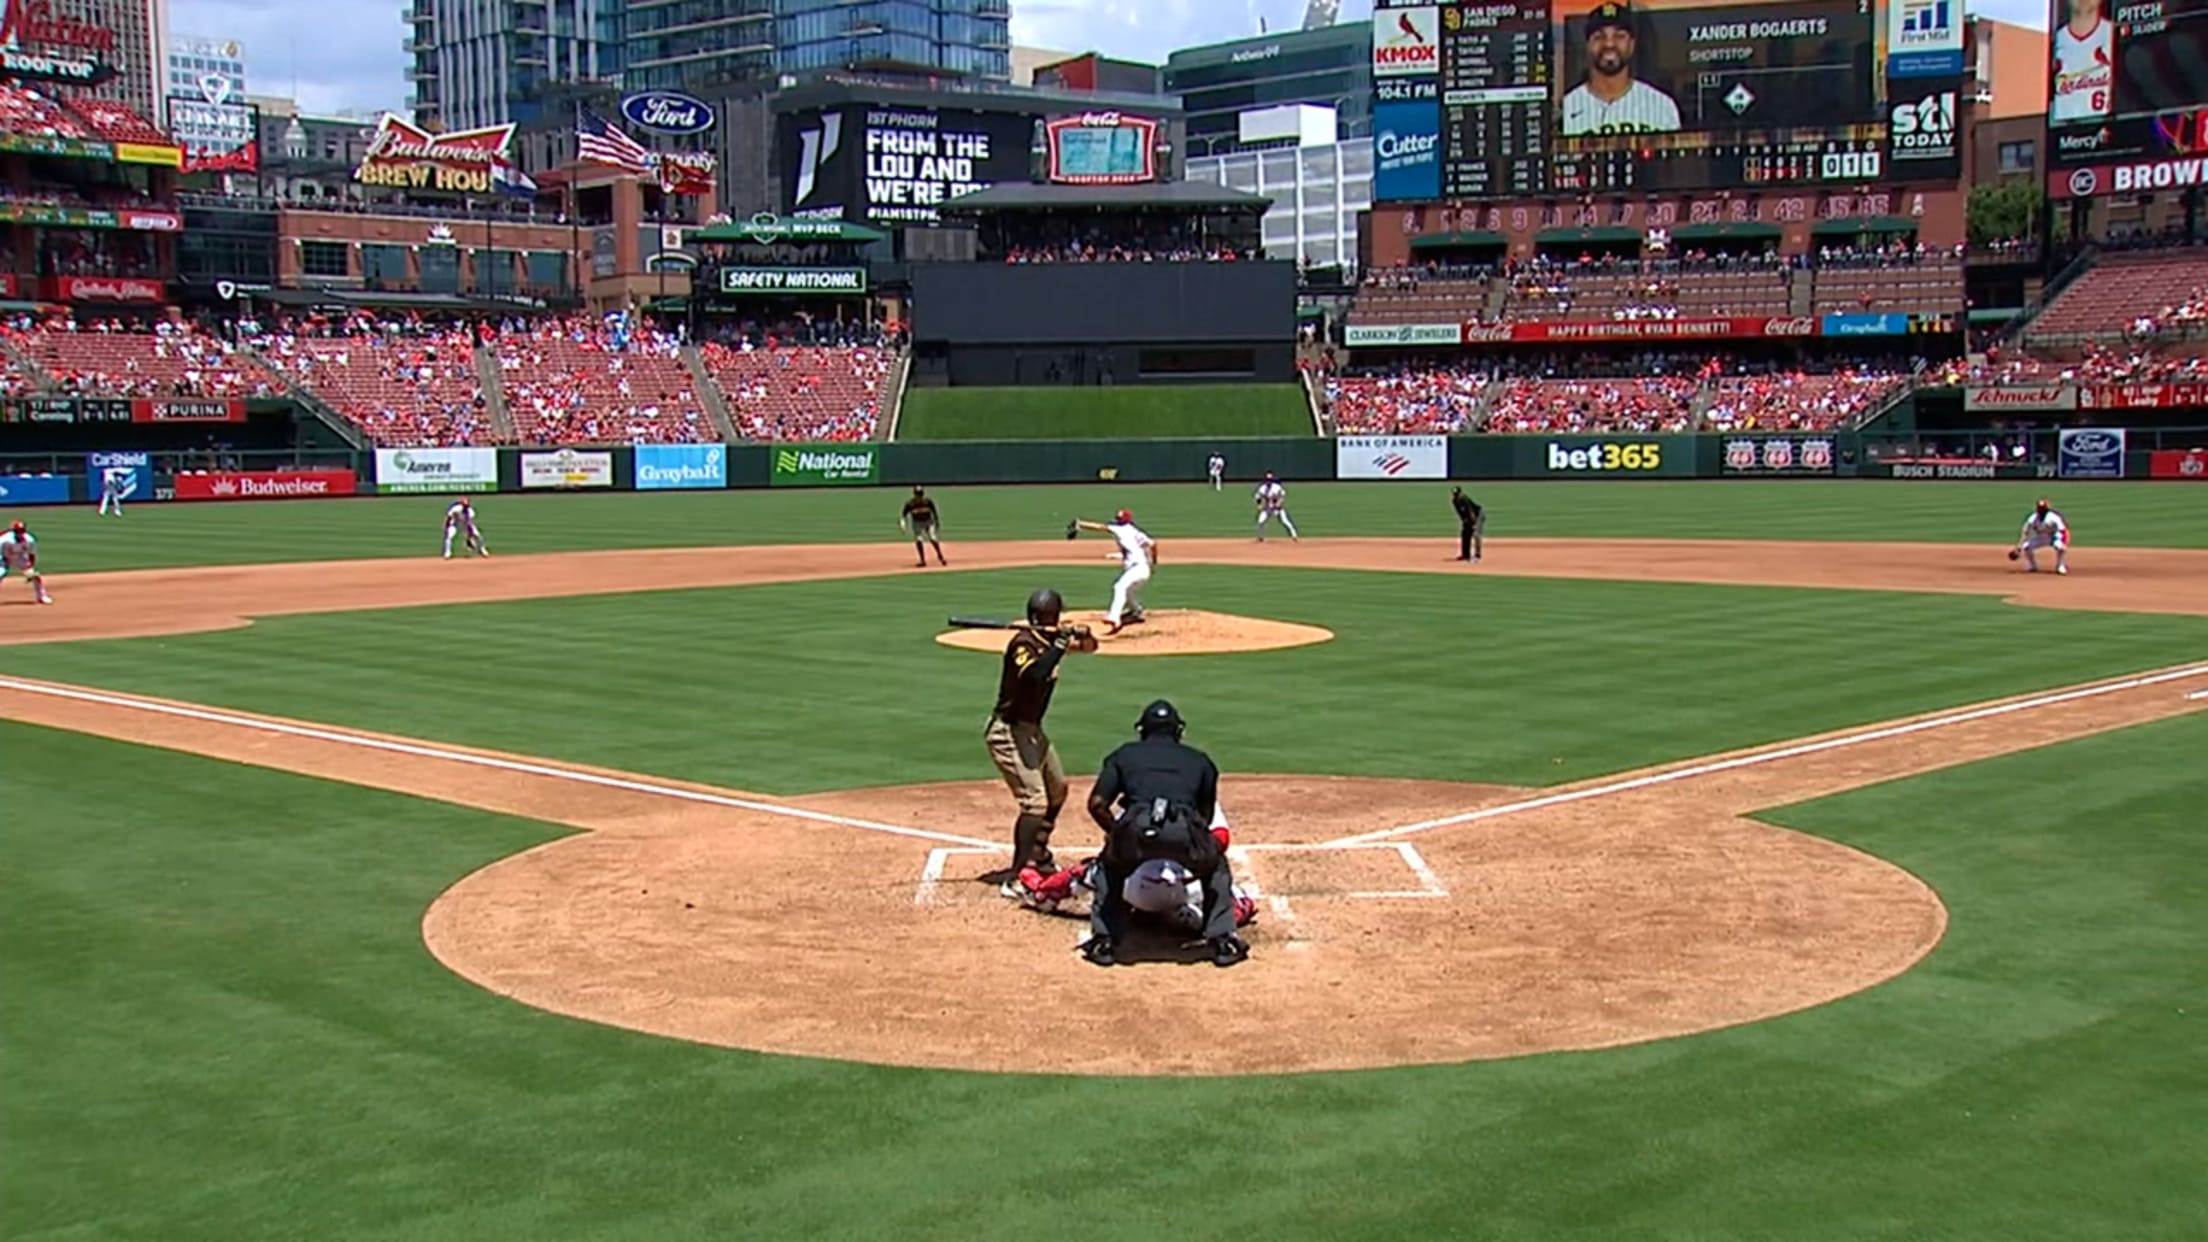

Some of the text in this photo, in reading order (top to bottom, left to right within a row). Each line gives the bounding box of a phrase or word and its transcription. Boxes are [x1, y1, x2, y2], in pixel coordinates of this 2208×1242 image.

[2117, 4, 2162, 21] PITCH
[1690, 19, 1827, 41] XANDER BOGAERTS
[1376, 45, 1435, 62] KMOX
[1690, 47, 1753, 62] SHORTSTOP
[5, 53, 94, 78] ROOFTOP
[1377, 85, 1437, 98] 104.1 FM
[2091, 91, 2109, 111] 6
[642, 98, 697, 127] Ford
[1892, 92, 1955, 133] stl
[367, 128, 500, 158] Budweise
[866, 128, 989, 158] FROM THE
[1379, 130, 1438, 158] Cutter
[1892, 133, 1955, 147] TODAY
[2059, 135, 2098, 149] Mercy
[361, 161, 492, 192] BREW HOU
[867, 154, 972, 181] LOU AND
[2114, 159, 2208, 191] BROW
[867, 179, 945, 205] WE'RE
[1773, 198, 1804, 221] 42
[728, 272, 859, 288] SAFETY NATIONAL
[1350, 325, 1457, 341] CLARKSON JEWELERS
[1468, 324, 1513, 341] Coca-Cola
[1549, 321, 1731, 337] HAPPY BIRTHDAY, RYAN BENNETT!
[1764, 318, 1812, 336] Coca-Cola
[1973, 385, 2062, 405] Schnucks
[170, 404, 225, 416] PURINA
[1340, 439, 1443, 449] BANK OF AMERICA
[2072, 433, 2110, 451] Ford
[91, 453, 147, 467] CarShield
[799, 452, 872, 471] National
[1549, 443, 1661, 470] bet365
[1893, 464, 1996, 478] BUSCH STADIUM
[240, 477, 328, 495] Budweiser
